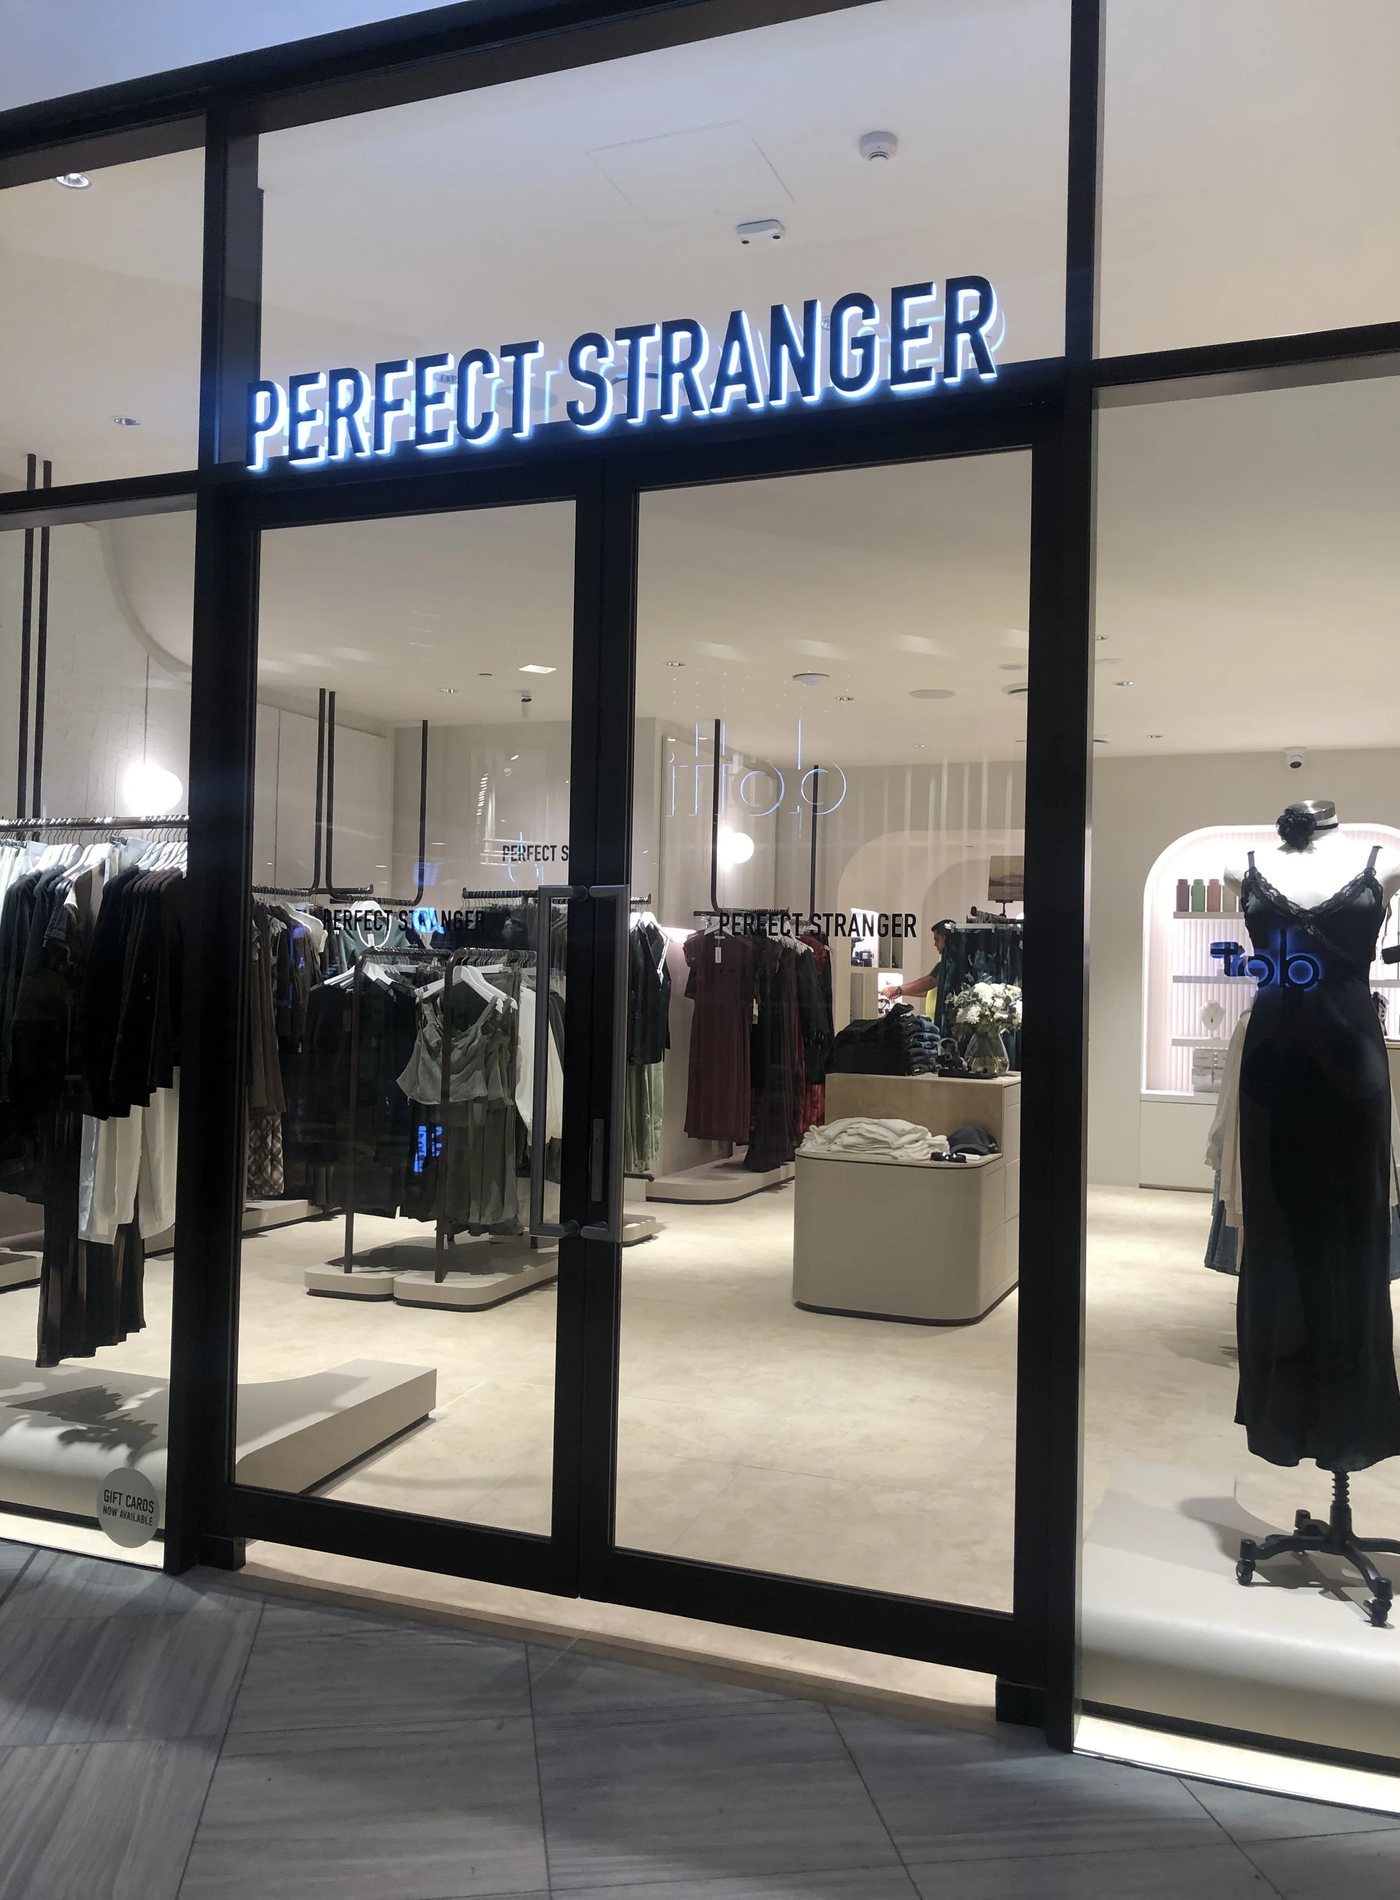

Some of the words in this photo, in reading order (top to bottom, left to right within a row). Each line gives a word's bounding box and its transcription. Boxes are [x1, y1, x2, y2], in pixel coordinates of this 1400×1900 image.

[246, 340, 543, 470] PERFECT
[566, 275, 998, 431] STRANGER
[502, 844, 557, 862] PERFECT
[322, 909, 393, 932] PERFECT
[719, 912, 803, 937] PERFECT
[809, 912, 917, 938] STRANGER
[104, 1490, 123, 1506] GIFT
[126, 1495, 155, 1513] CARDS
[103, 1506, 118, 1517] NOW
[120, 1510, 153, 1526] AVAILABLE
